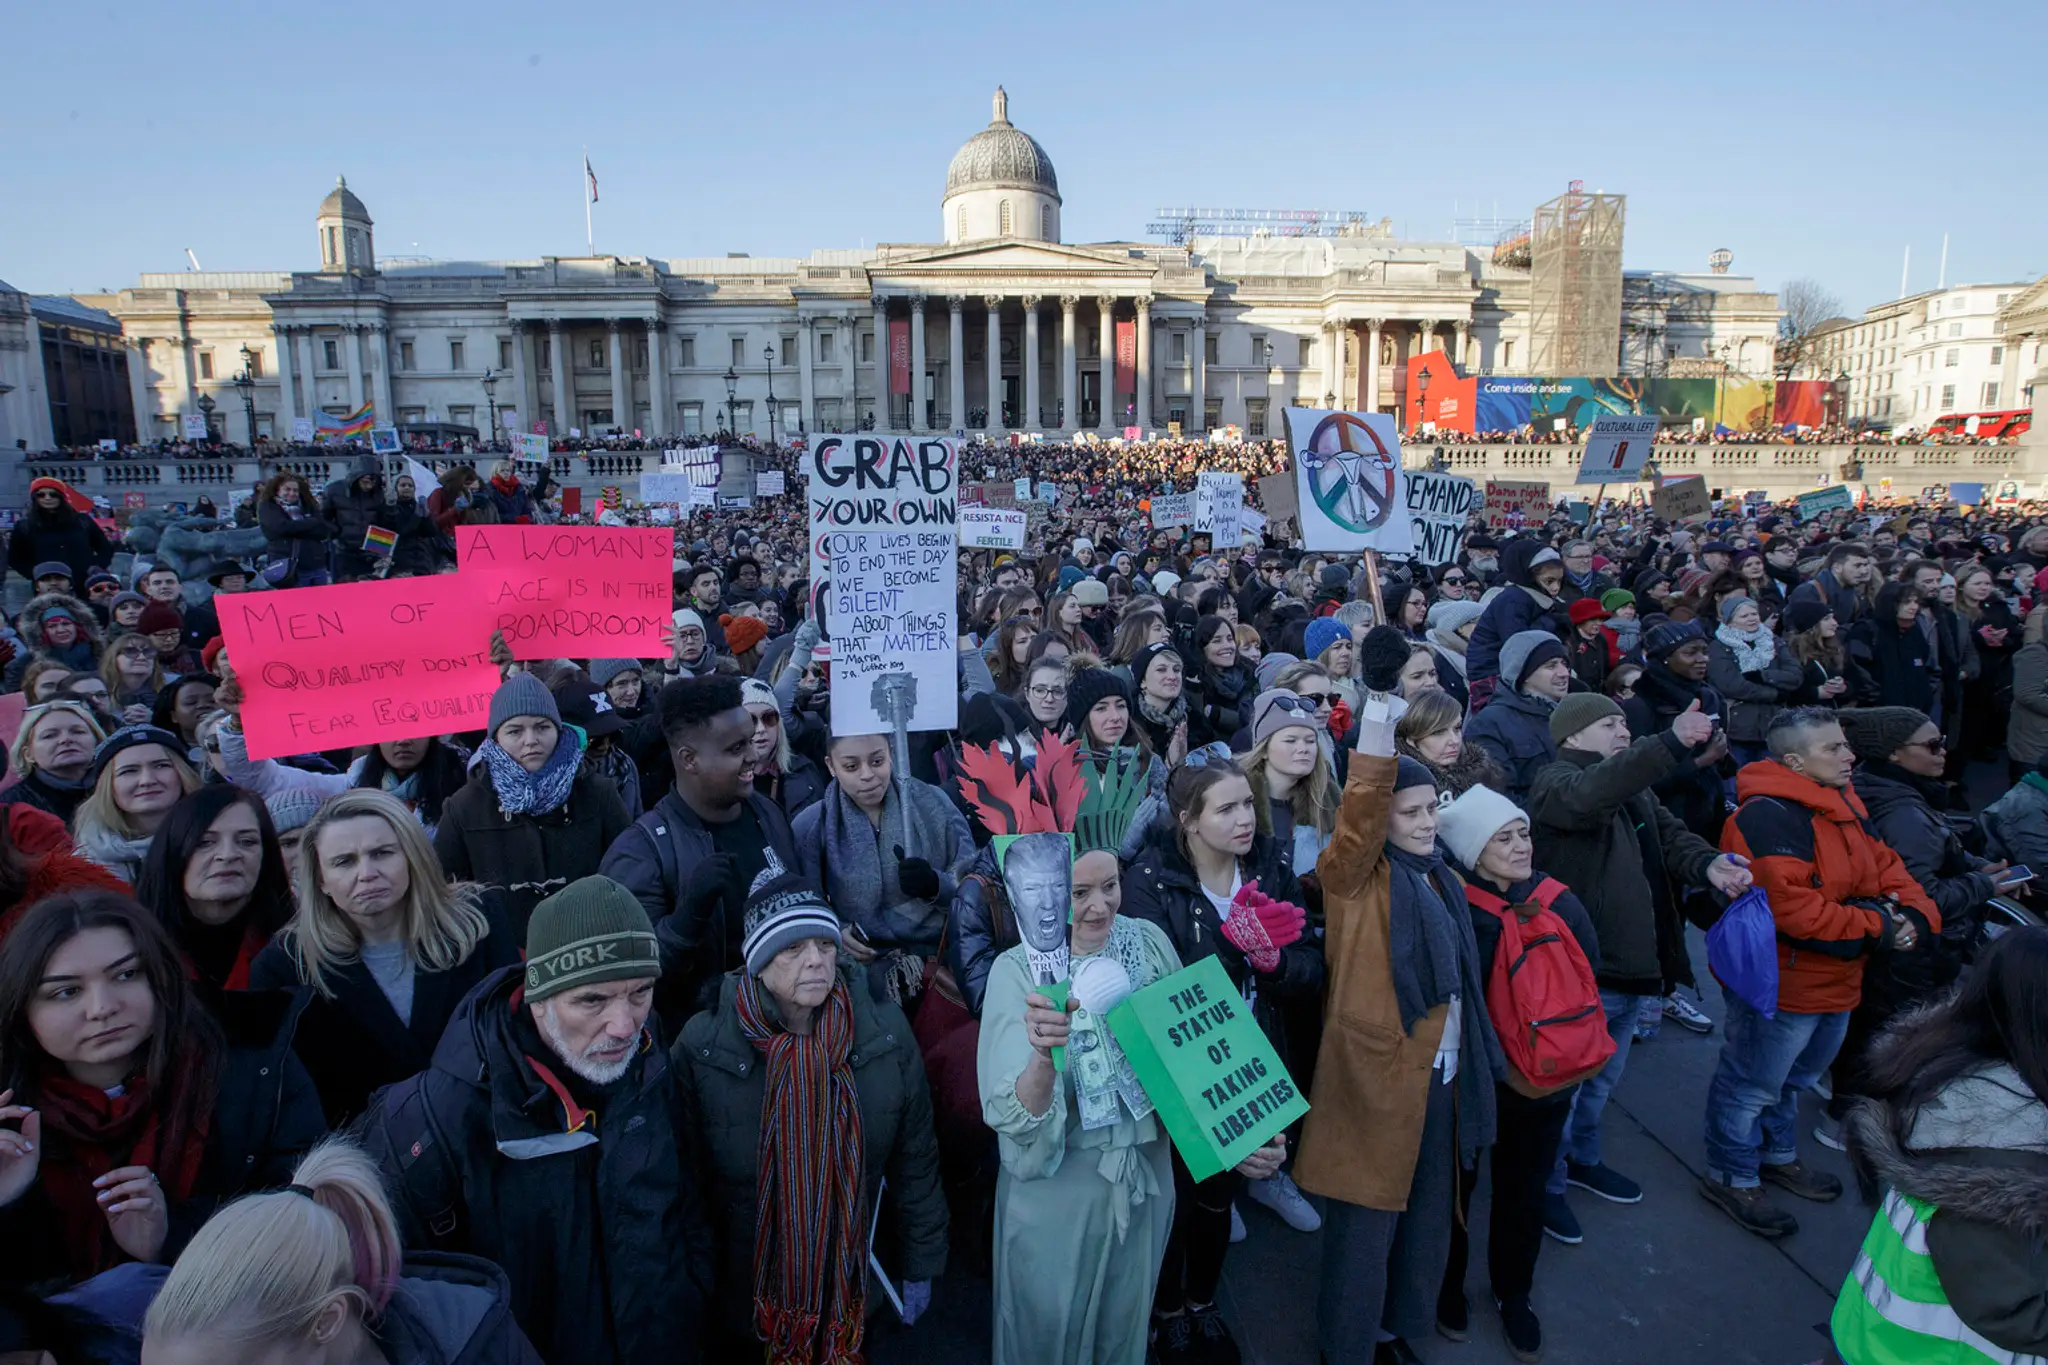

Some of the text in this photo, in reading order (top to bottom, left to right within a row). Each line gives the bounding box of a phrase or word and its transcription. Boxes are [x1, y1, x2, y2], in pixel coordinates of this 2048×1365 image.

[1484, 382, 1572, 393] Come inside and see
[1595, 421, 1655, 432] CULTURAL LEFT
[664, 445, 719, 464] DUMP
[815, 437, 951, 494] GRAB
[685, 462, 719, 486] UMP
[1487, 483, 1547, 502] Damn right
[812, 498, 956, 525] YOUR OWN
[467, 529, 668, 562] A WOMAN'S
[833, 533, 867, 554] OUR
[917, 533, 952, 547] BEGIN
[976, 536, 1013, 547] FERTILE
[832, 549, 949, 574] TO END THE DAY
[488, 577, 668, 606] ACE IS IN THE
[837, 567, 940, 593] WE BECOME
[839, 589, 904, 614] SILENT
[242, 602, 435, 644] MEN OF
[497, 608, 663, 644] BOARDROOM
[852, 610, 947, 633] ABOUT THINGS
[832, 631, 951, 653] THAT MATTER
[262, 652, 484, 691] QUALITY DON'T
[288, 712, 360, 738] FEAR
[544, 942, 620, 976] YORK
[1168, 983, 1208, 1014] THE
[1167, 999, 1236, 1048] STATUE
[1206, 1037, 1231, 1065] OF
[1202, 1056, 1268, 1111] TAKING
[1211, 1078, 1295, 1148] LIBERTIES
